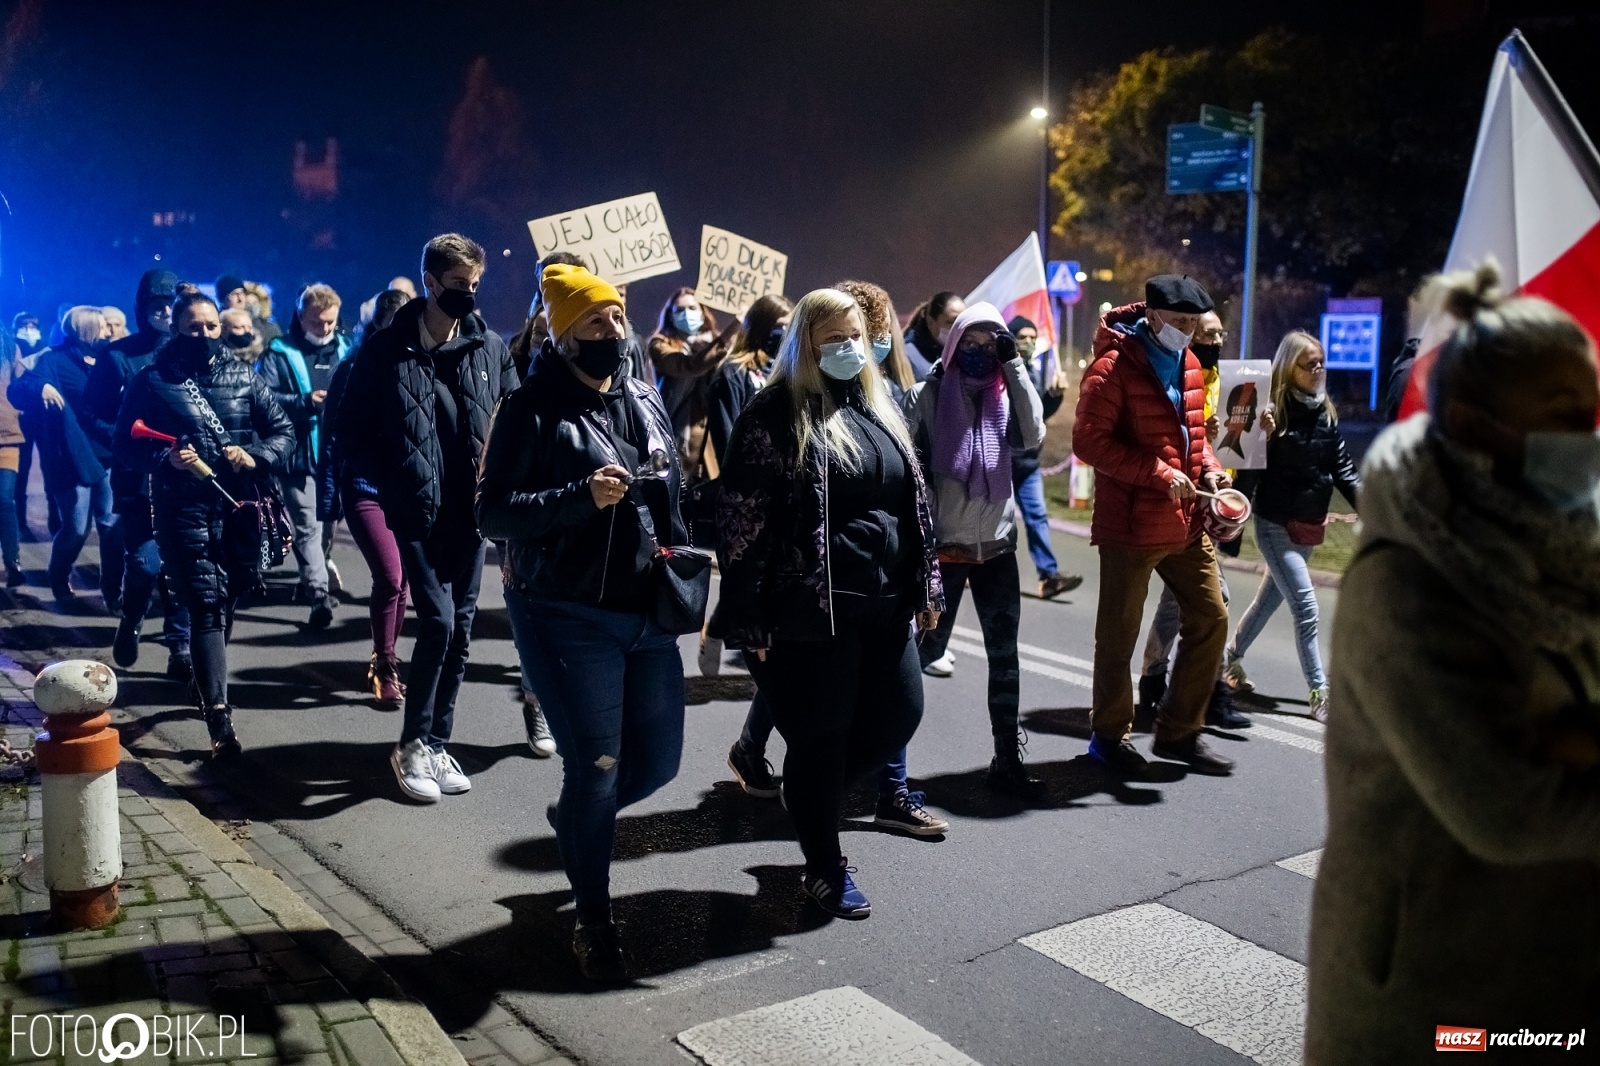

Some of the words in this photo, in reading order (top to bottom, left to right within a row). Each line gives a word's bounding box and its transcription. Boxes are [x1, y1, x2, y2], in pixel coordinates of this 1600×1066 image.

[543, 213, 593, 252] JEJ
[603, 202, 658, 234] CIAŁO
[603, 231, 675, 270] WYBÓR
[705, 234, 729, 261] GO
[738, 243, 782, 278] DUCK
[703, 260, 772, 296] YOURSELF
